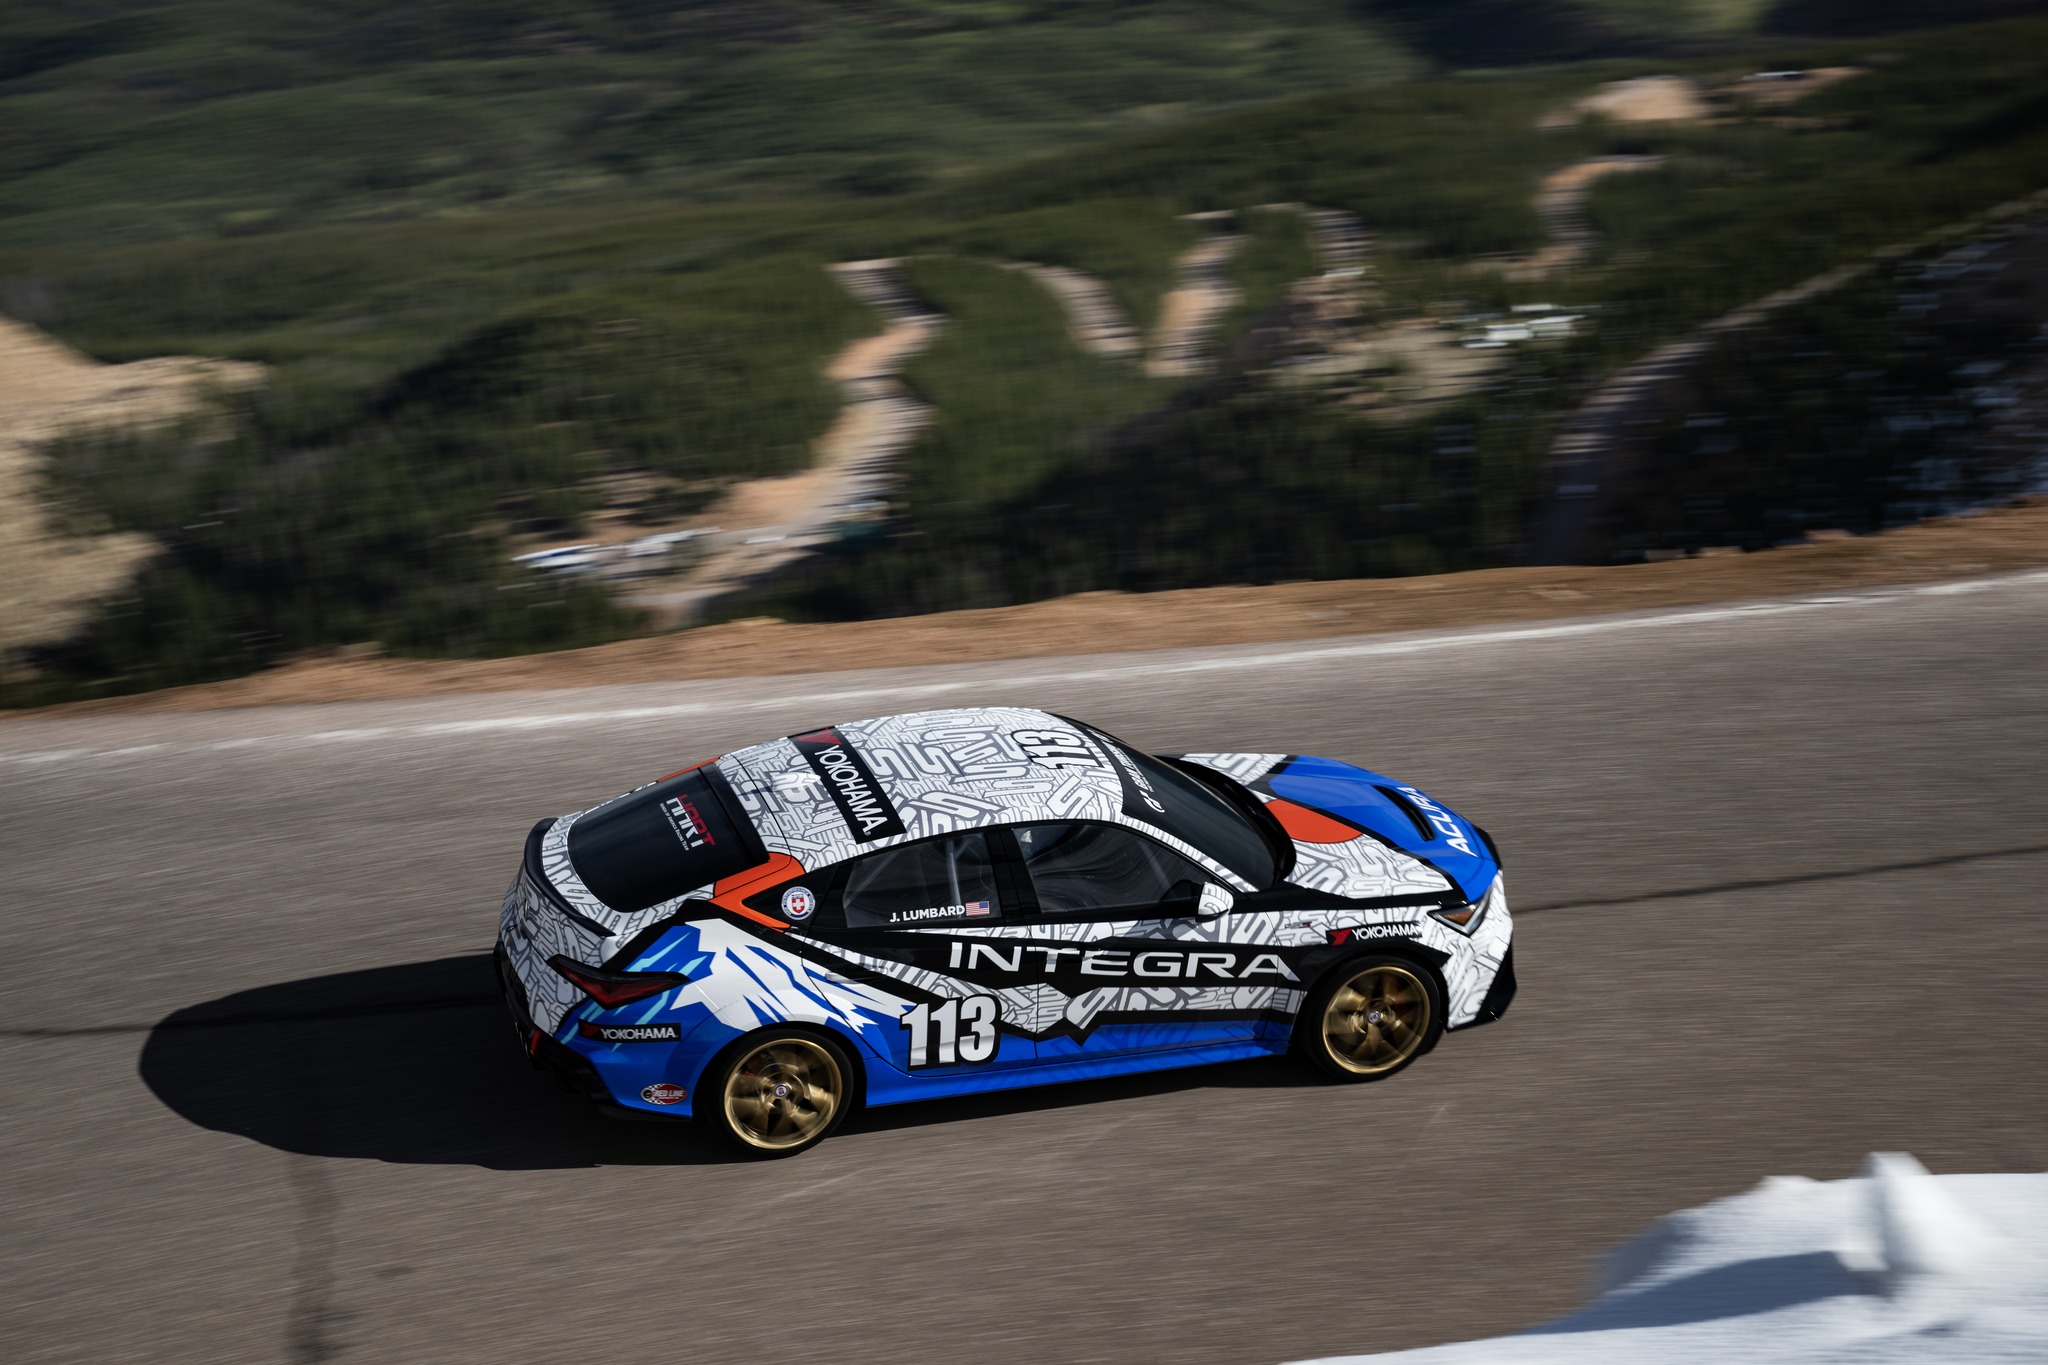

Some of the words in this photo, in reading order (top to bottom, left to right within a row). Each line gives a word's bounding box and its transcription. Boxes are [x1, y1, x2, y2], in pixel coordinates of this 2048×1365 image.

[1010, 729, 1102, 769] 113
[814, 744, 888, 833] YOKOHAMA
[666, 794, 716, 848] HART
[1396, 787, 1479, 858] ACURA
[889, 912, 901, 923] J.
[903, 905, 966, 922] LUMBARD
[1351, 923, 1418, 941] YOKOHAMA
[949, 942, 1301, 982] INTEGRA
[600, 1027, 677, 1040] YOKOHAMA
[900, 995, 1000, 1069] 113
